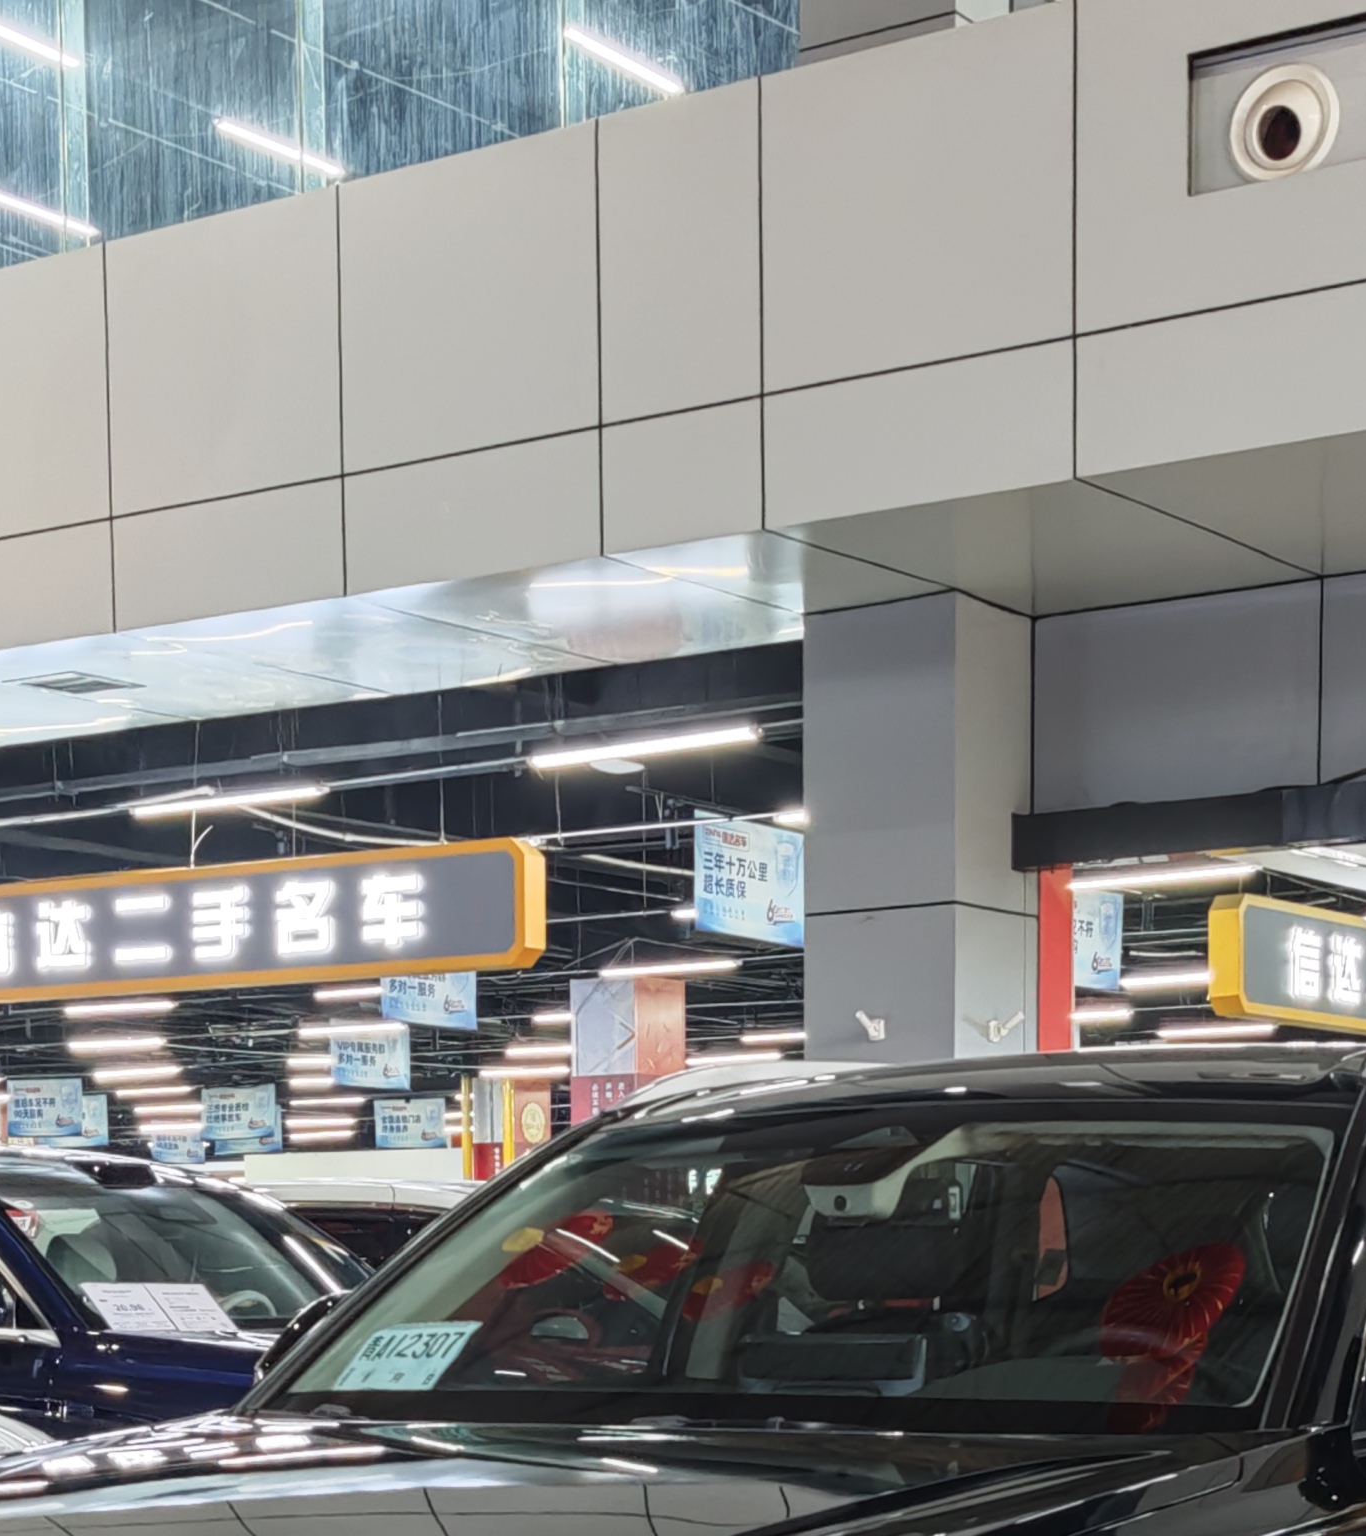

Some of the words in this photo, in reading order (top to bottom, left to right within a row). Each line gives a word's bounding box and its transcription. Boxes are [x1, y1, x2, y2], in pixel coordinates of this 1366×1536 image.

[703, 850, 769, 883] 三年十万公里
[703, 873, 748, 901] 超长质保
[388, 979, 436, 999] 多对一服务
